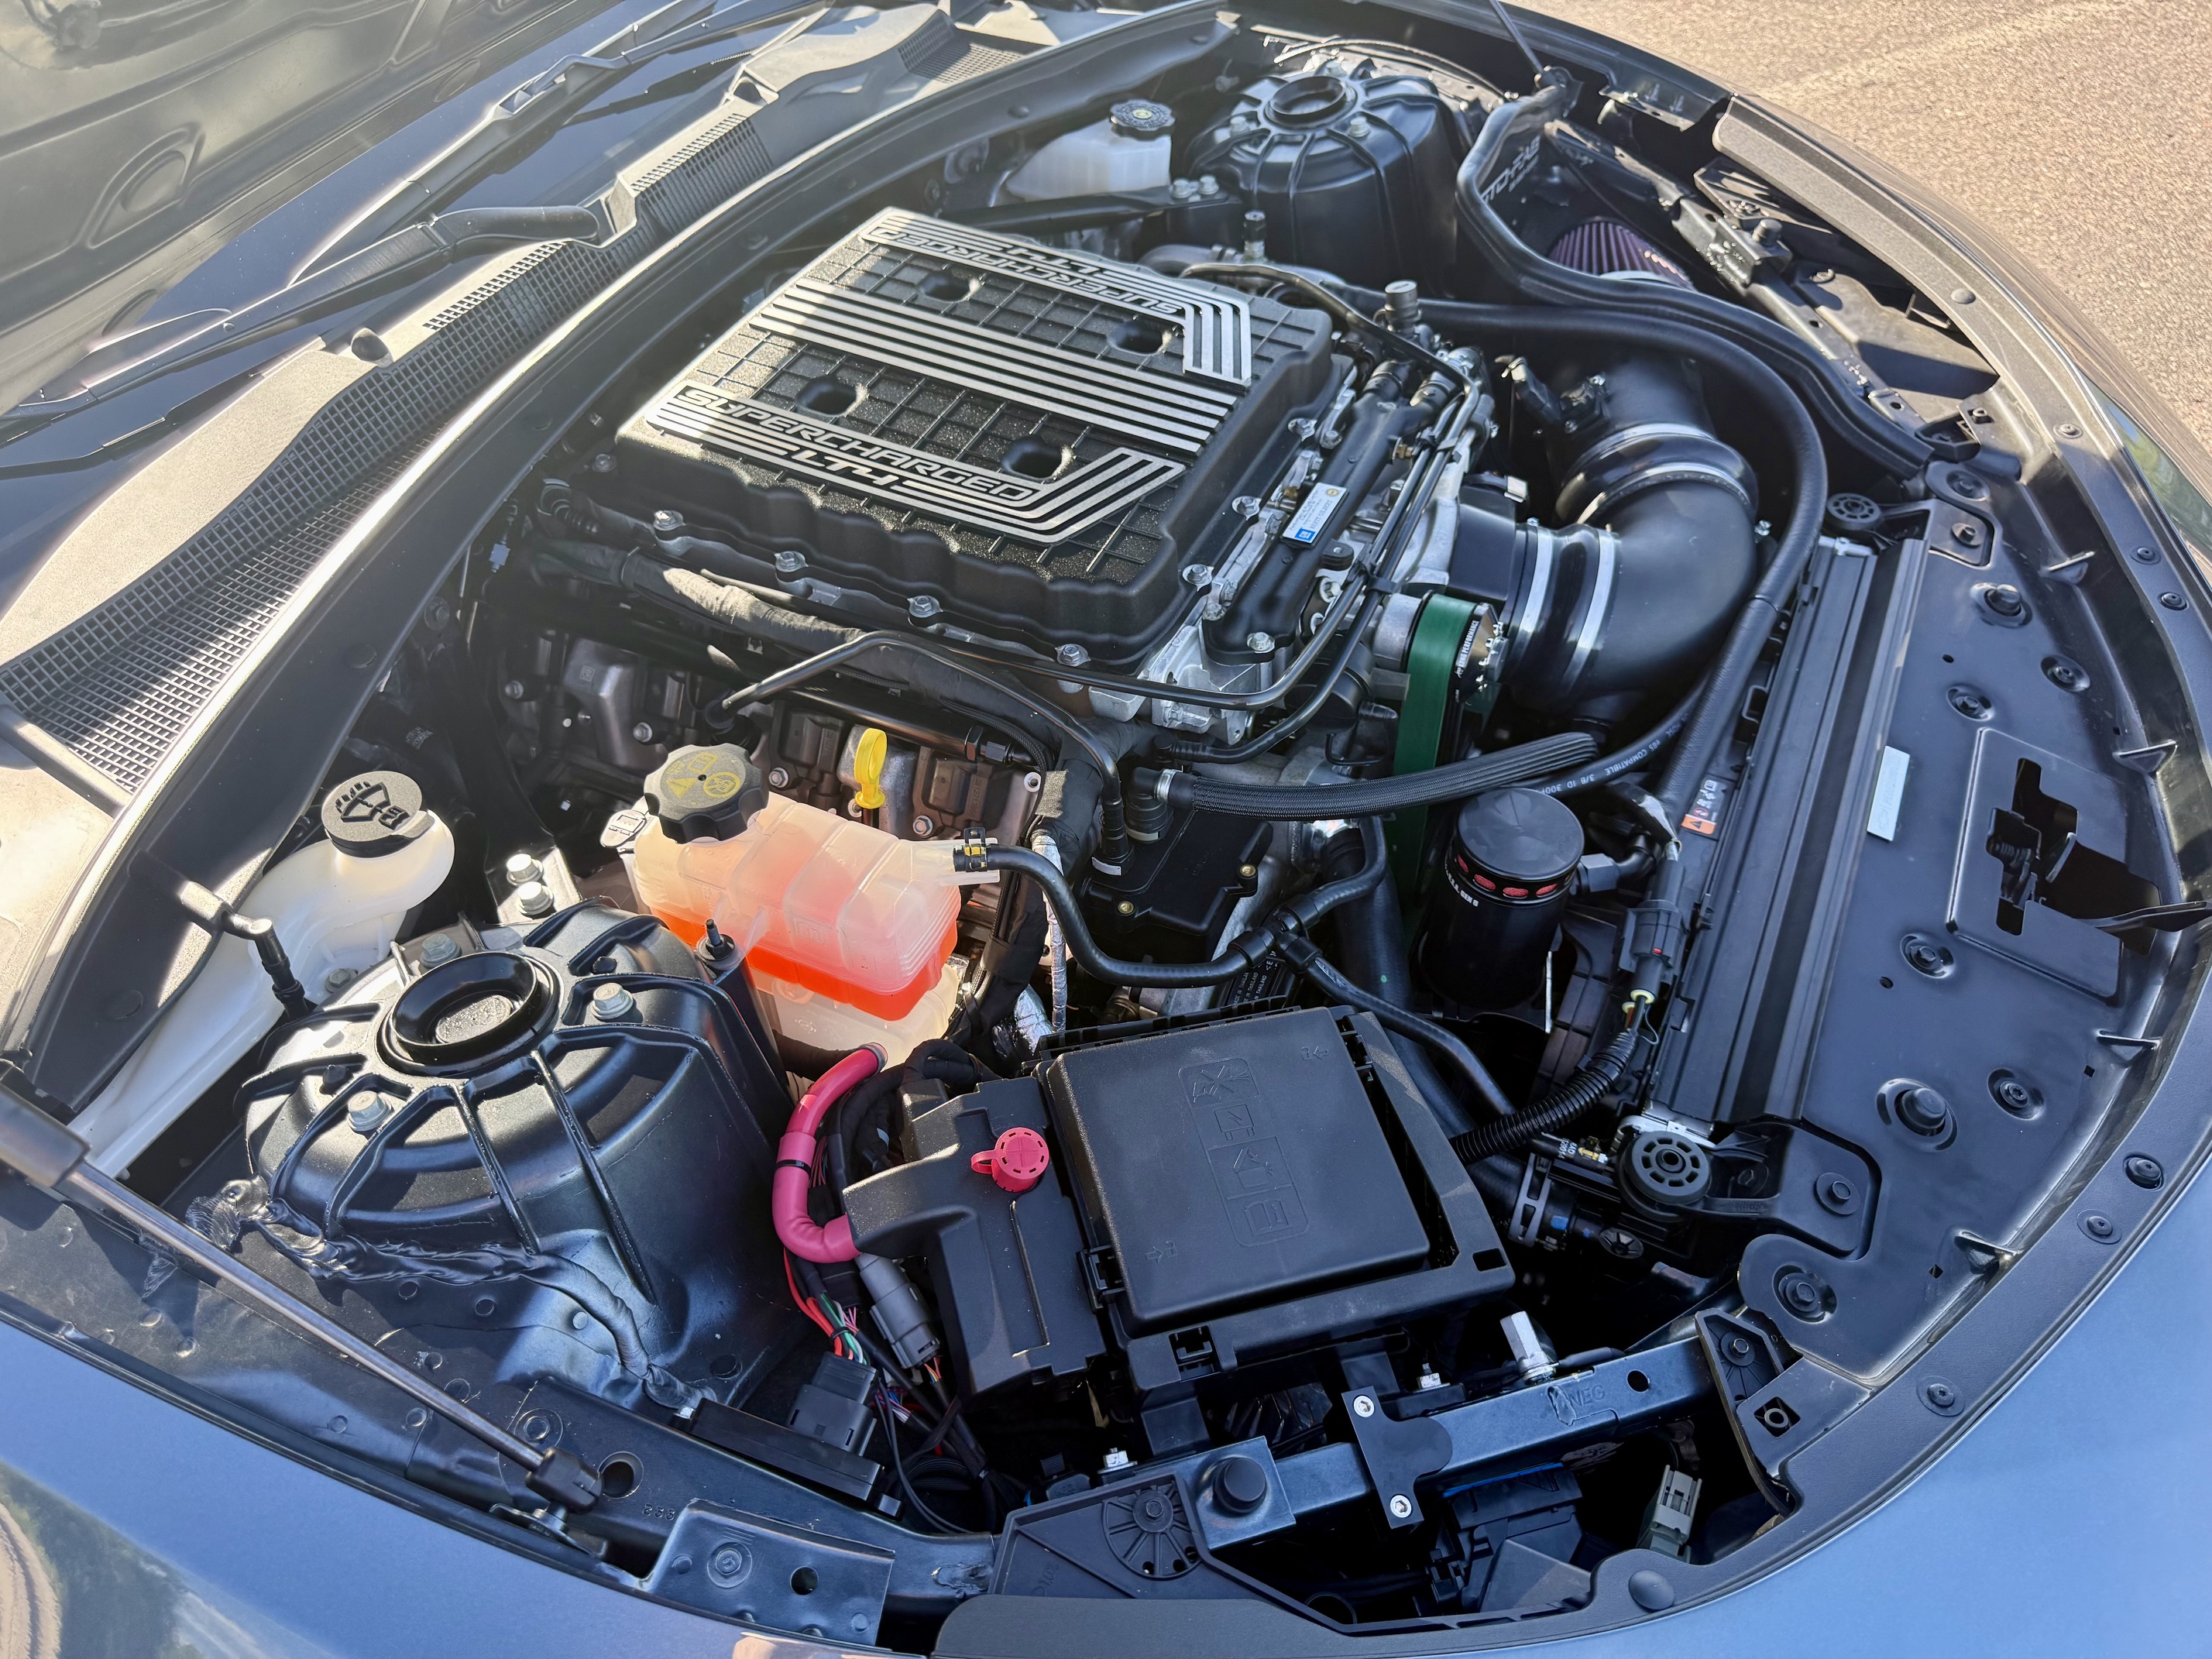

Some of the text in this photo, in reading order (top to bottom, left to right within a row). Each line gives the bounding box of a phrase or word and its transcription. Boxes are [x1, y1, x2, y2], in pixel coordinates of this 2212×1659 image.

[867, 226, 1184, 315] SUPERCHARGED
[1004, 246, 1101, 277] LT4
[675, 386, 1038, 502] SUPERCHARGED
[786, 448, 901, 487] LT4
[1462, 620, 1480, 654] PERFORMANCE
[1603, 747, 1647, 776] COMPATIBLE
[1579, 772, 1595, 786] 3/8
[1248, 972, 1259, 991] THAILAND
[1256, 974, 1267, 994] THAILAND
[1568, 1385, 1605, 1407] NEG
